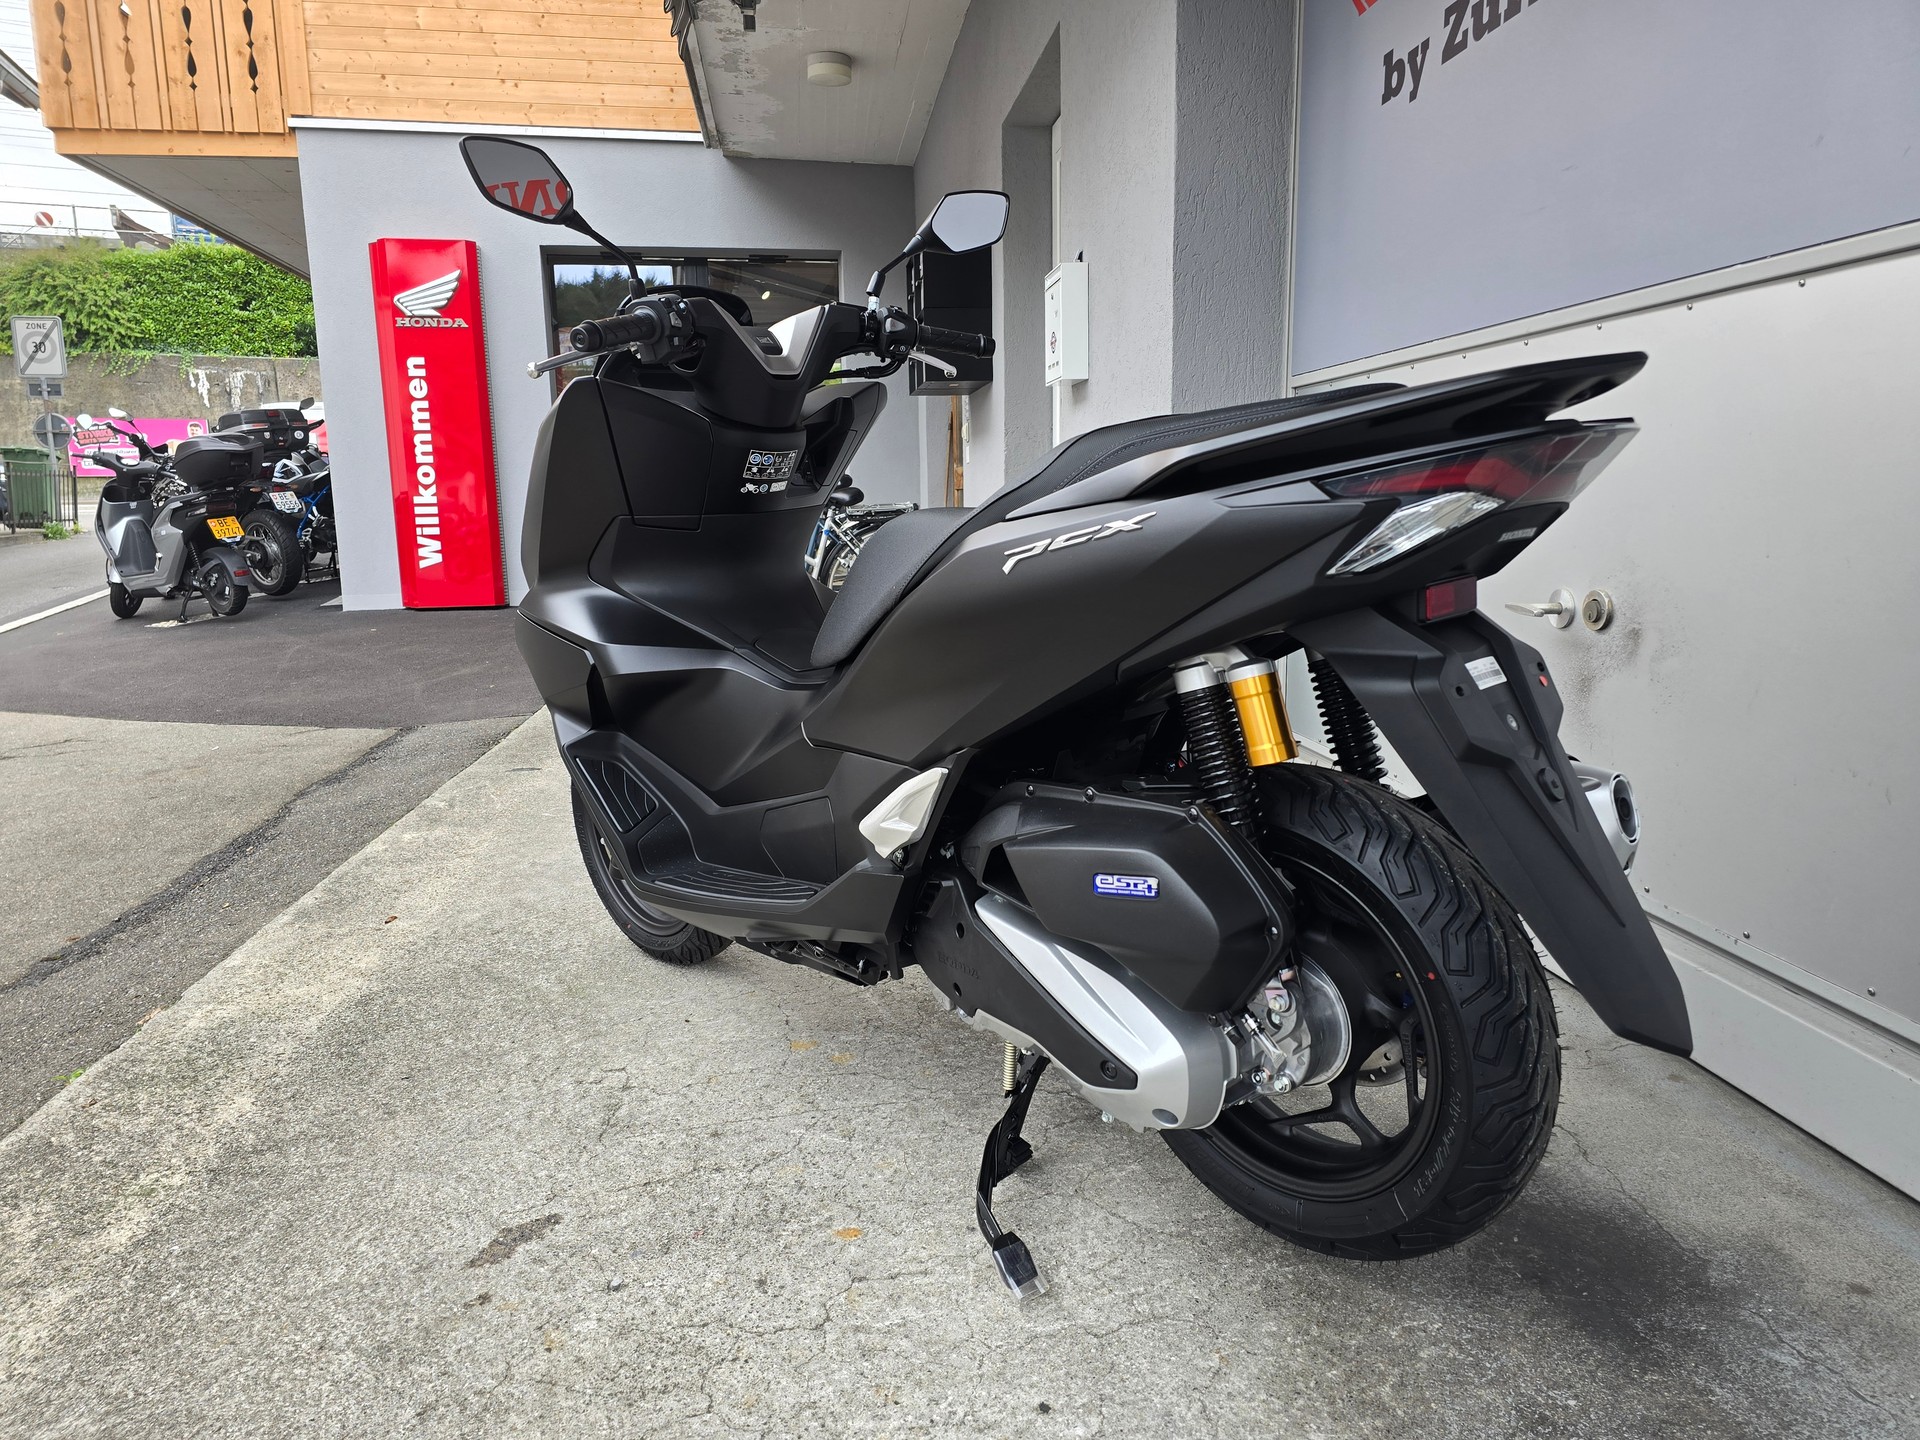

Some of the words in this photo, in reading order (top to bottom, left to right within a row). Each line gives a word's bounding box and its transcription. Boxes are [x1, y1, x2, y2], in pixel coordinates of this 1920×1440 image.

[1381, 36, 1430, 106] by
[25, 322, 48, 330] ZONE
[395, 317, 469, 328] HONDA
[31, 341, 47, 354] 30
[406, 356, 443, 569] Willkommen
[217, 519, 230, 527] BE
[215, 526, 241, 538] 39747
[1002, 511, 1157, 575] PCX
